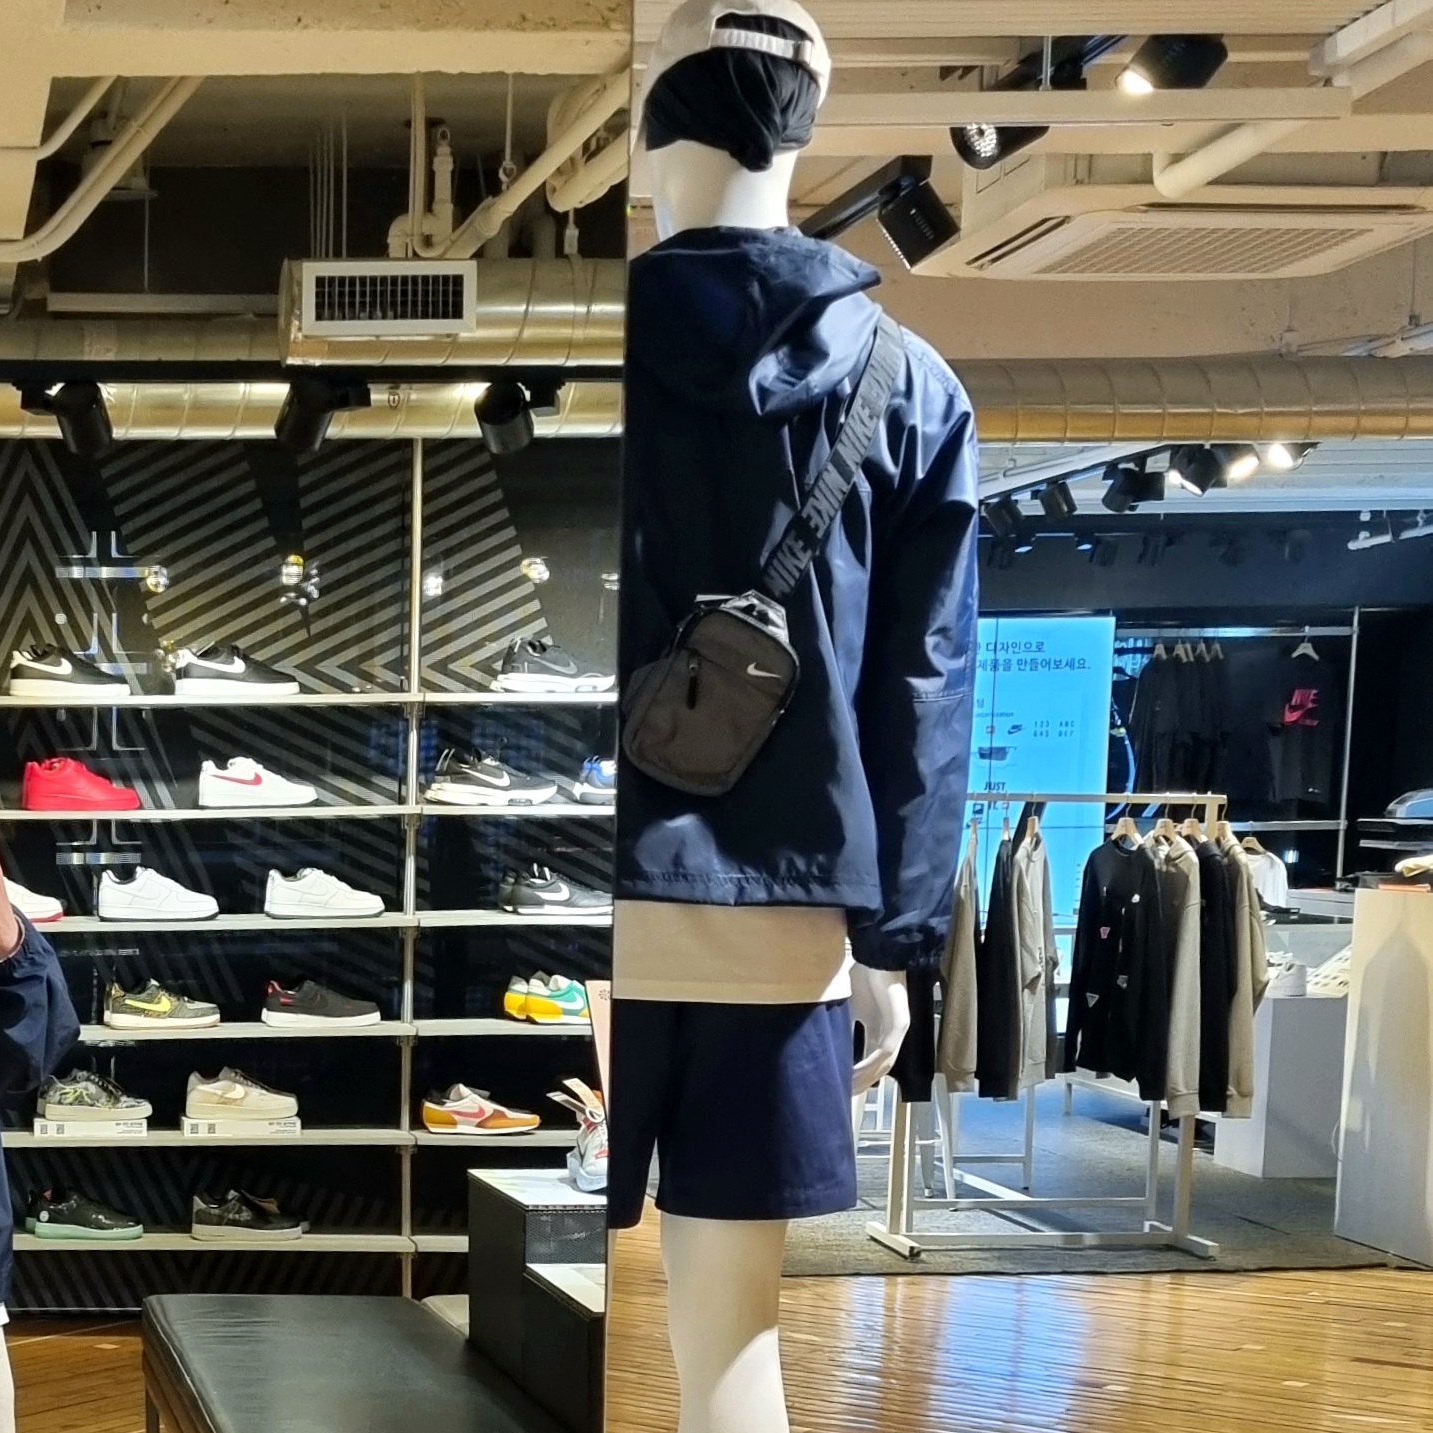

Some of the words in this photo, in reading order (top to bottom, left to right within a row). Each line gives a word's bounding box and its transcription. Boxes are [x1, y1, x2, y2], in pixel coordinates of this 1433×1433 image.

[836, 397, 879, 470] NIKE
[800, 466, 849, 540] NIKE
[765, 525, 814, 598] NIKE
[986, 640, 1046, 655] 디자인으로
[1017, 658, 1091, 672] 만들어보세요.
[983, 781, 1007, 791] JUST
